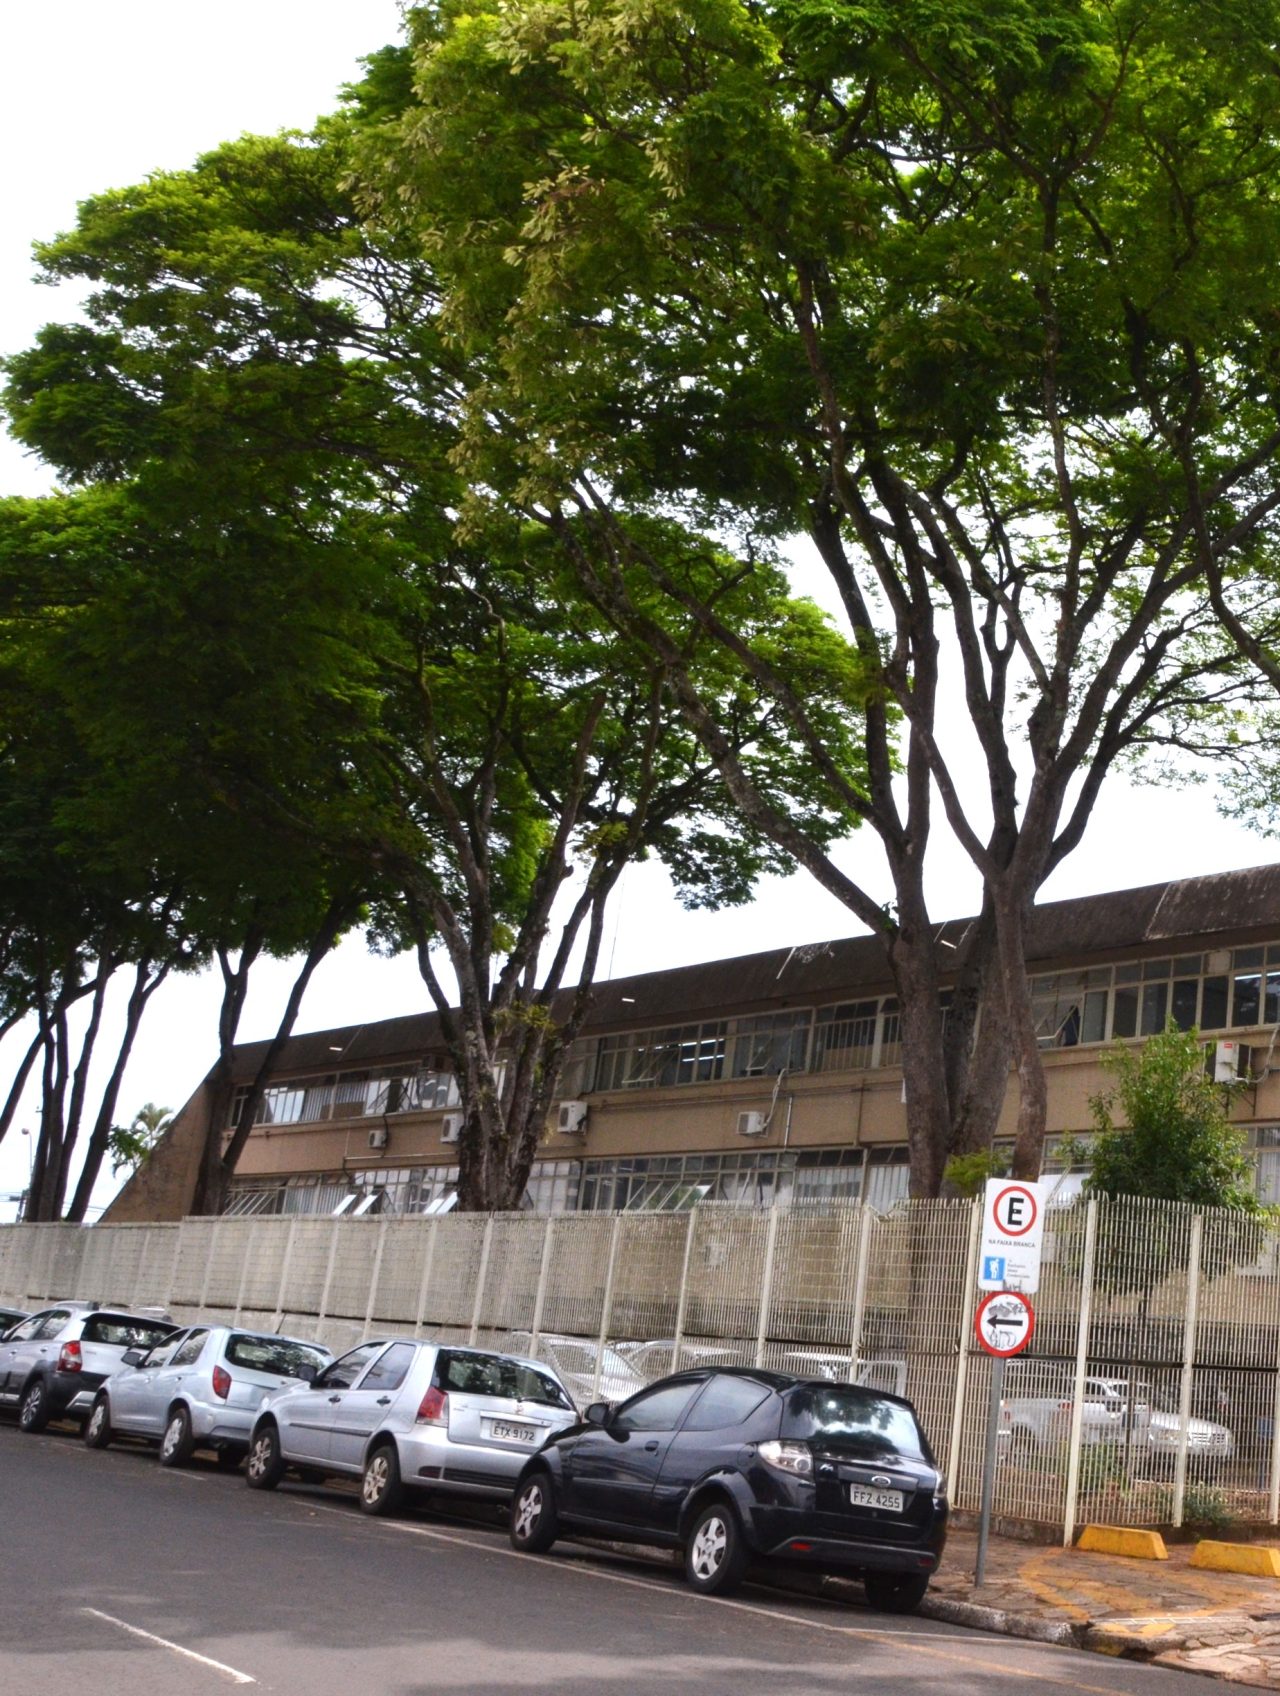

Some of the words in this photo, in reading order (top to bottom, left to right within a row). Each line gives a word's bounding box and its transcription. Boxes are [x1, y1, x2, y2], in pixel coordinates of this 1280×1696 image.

[1007, 1197, 1024, 1226] E
[512, 1428, 535, 1441] 9172
[853, 1491, 872, 1504] FFZ
[875, 1493, 900, 1509] 4255
